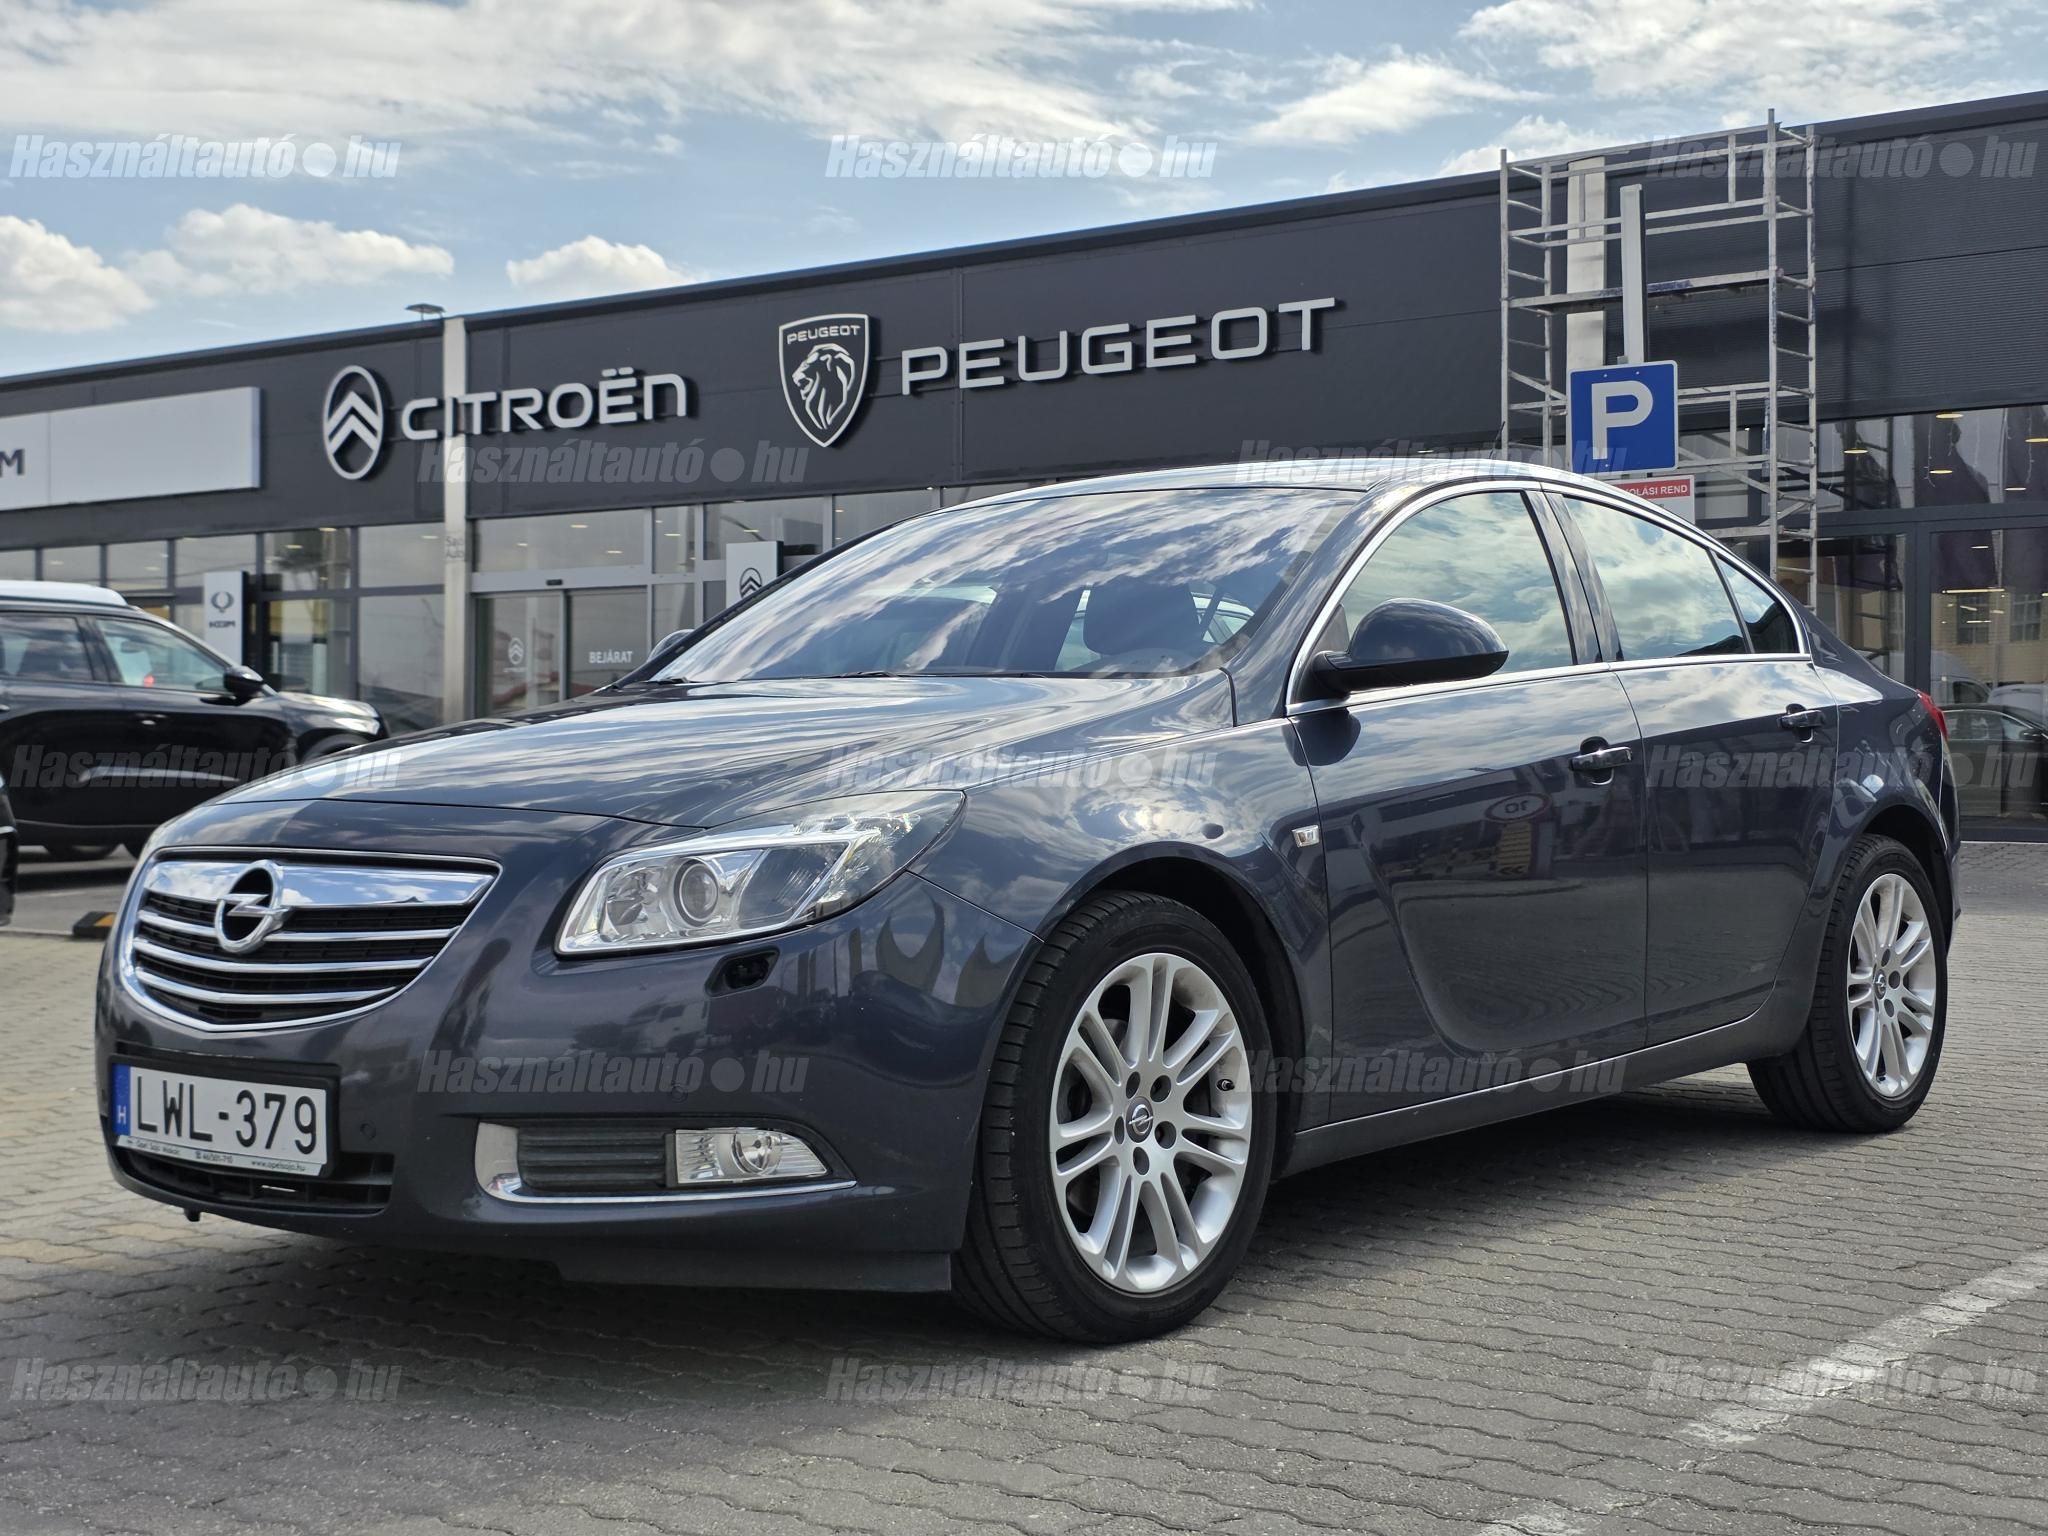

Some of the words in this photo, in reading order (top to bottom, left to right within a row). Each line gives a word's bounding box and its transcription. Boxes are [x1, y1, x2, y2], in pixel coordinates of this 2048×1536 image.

[786, 324, 861, 345] PEUGEOT
[902, 297, 1336, 396] PEUGEOT
[401, 366, 687, 441] CITROËN
[1592, 380, 1654, 460] P
[1660, 484, 1688, 495] REND
[588, 649, 633, 664] BEJÁRAT
[117, 1104, 127, 1125] H
[138, 1076, 317, 1155] LWL-379
